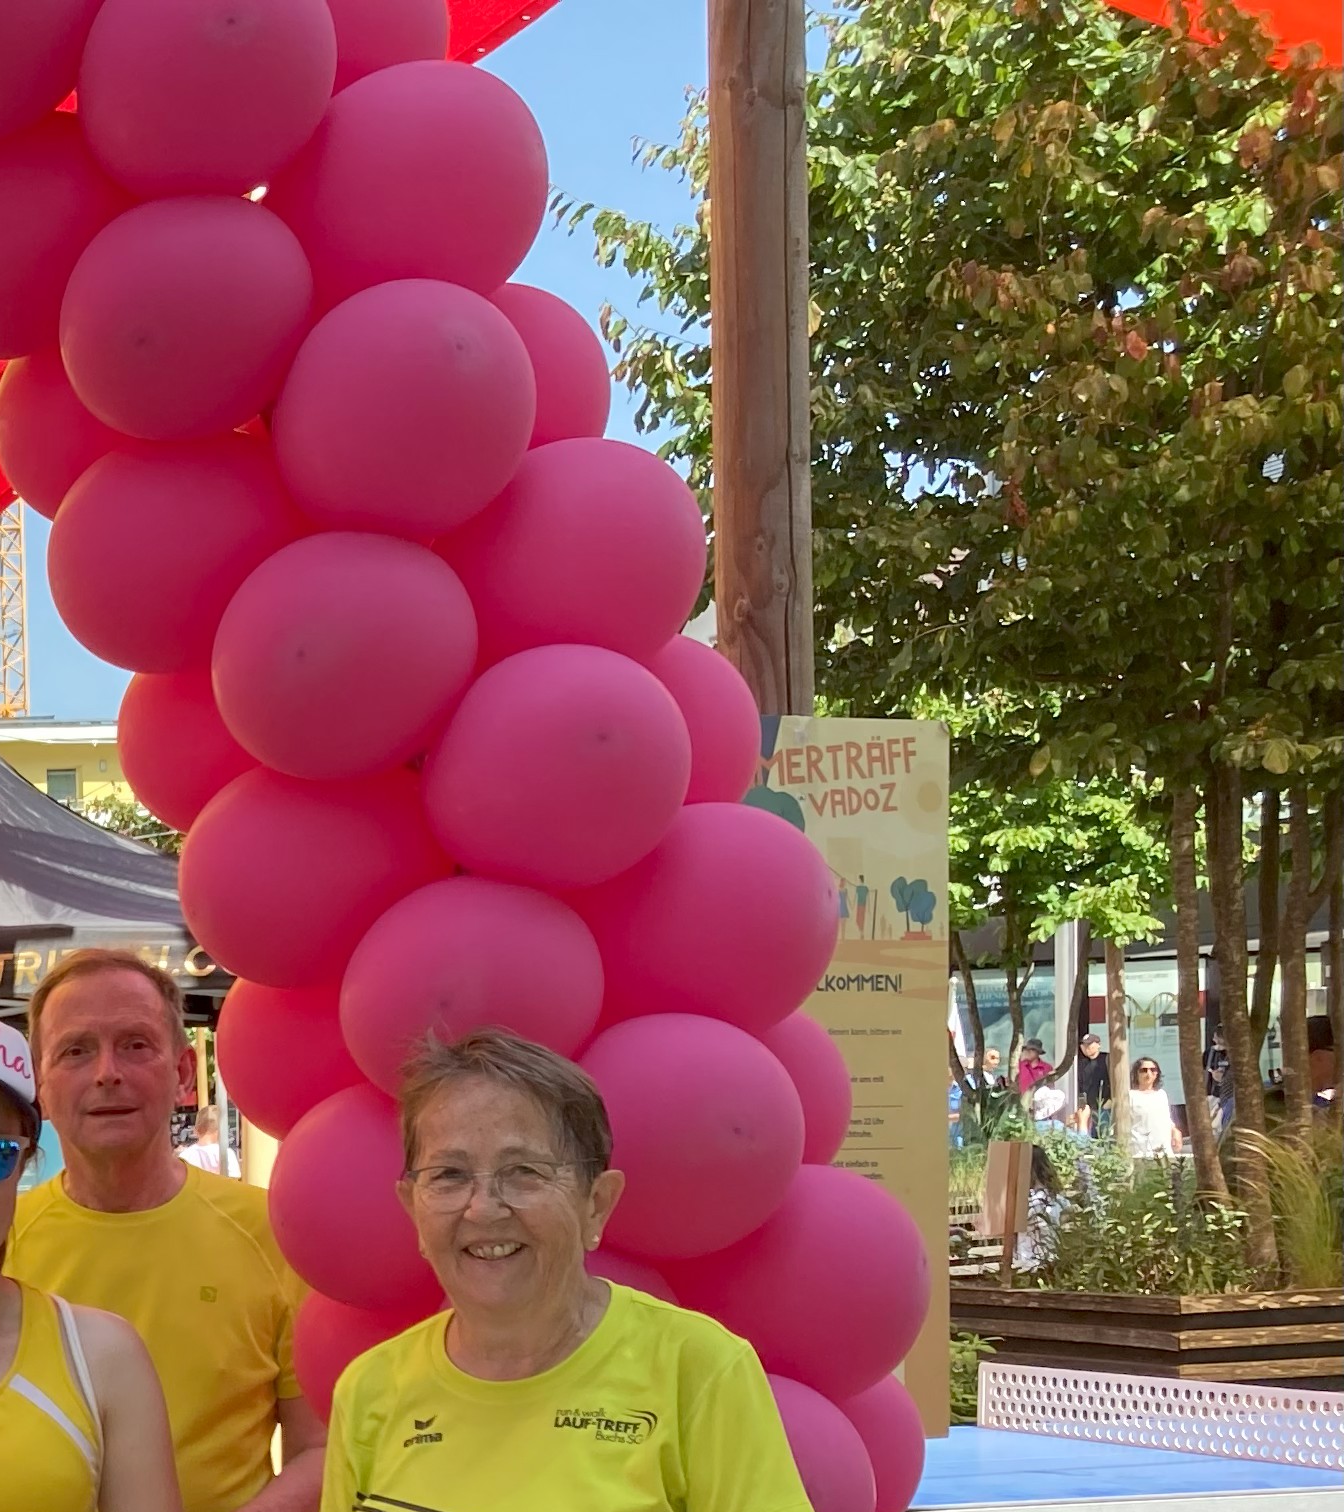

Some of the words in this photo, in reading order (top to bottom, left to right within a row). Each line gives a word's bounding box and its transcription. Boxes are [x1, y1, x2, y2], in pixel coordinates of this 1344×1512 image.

[754, 735, 917, 787] MERTRÄFF
[554, 1417, 641, 1434] LAUF-TREFF
[403, 1431, 443, 1448] erima
